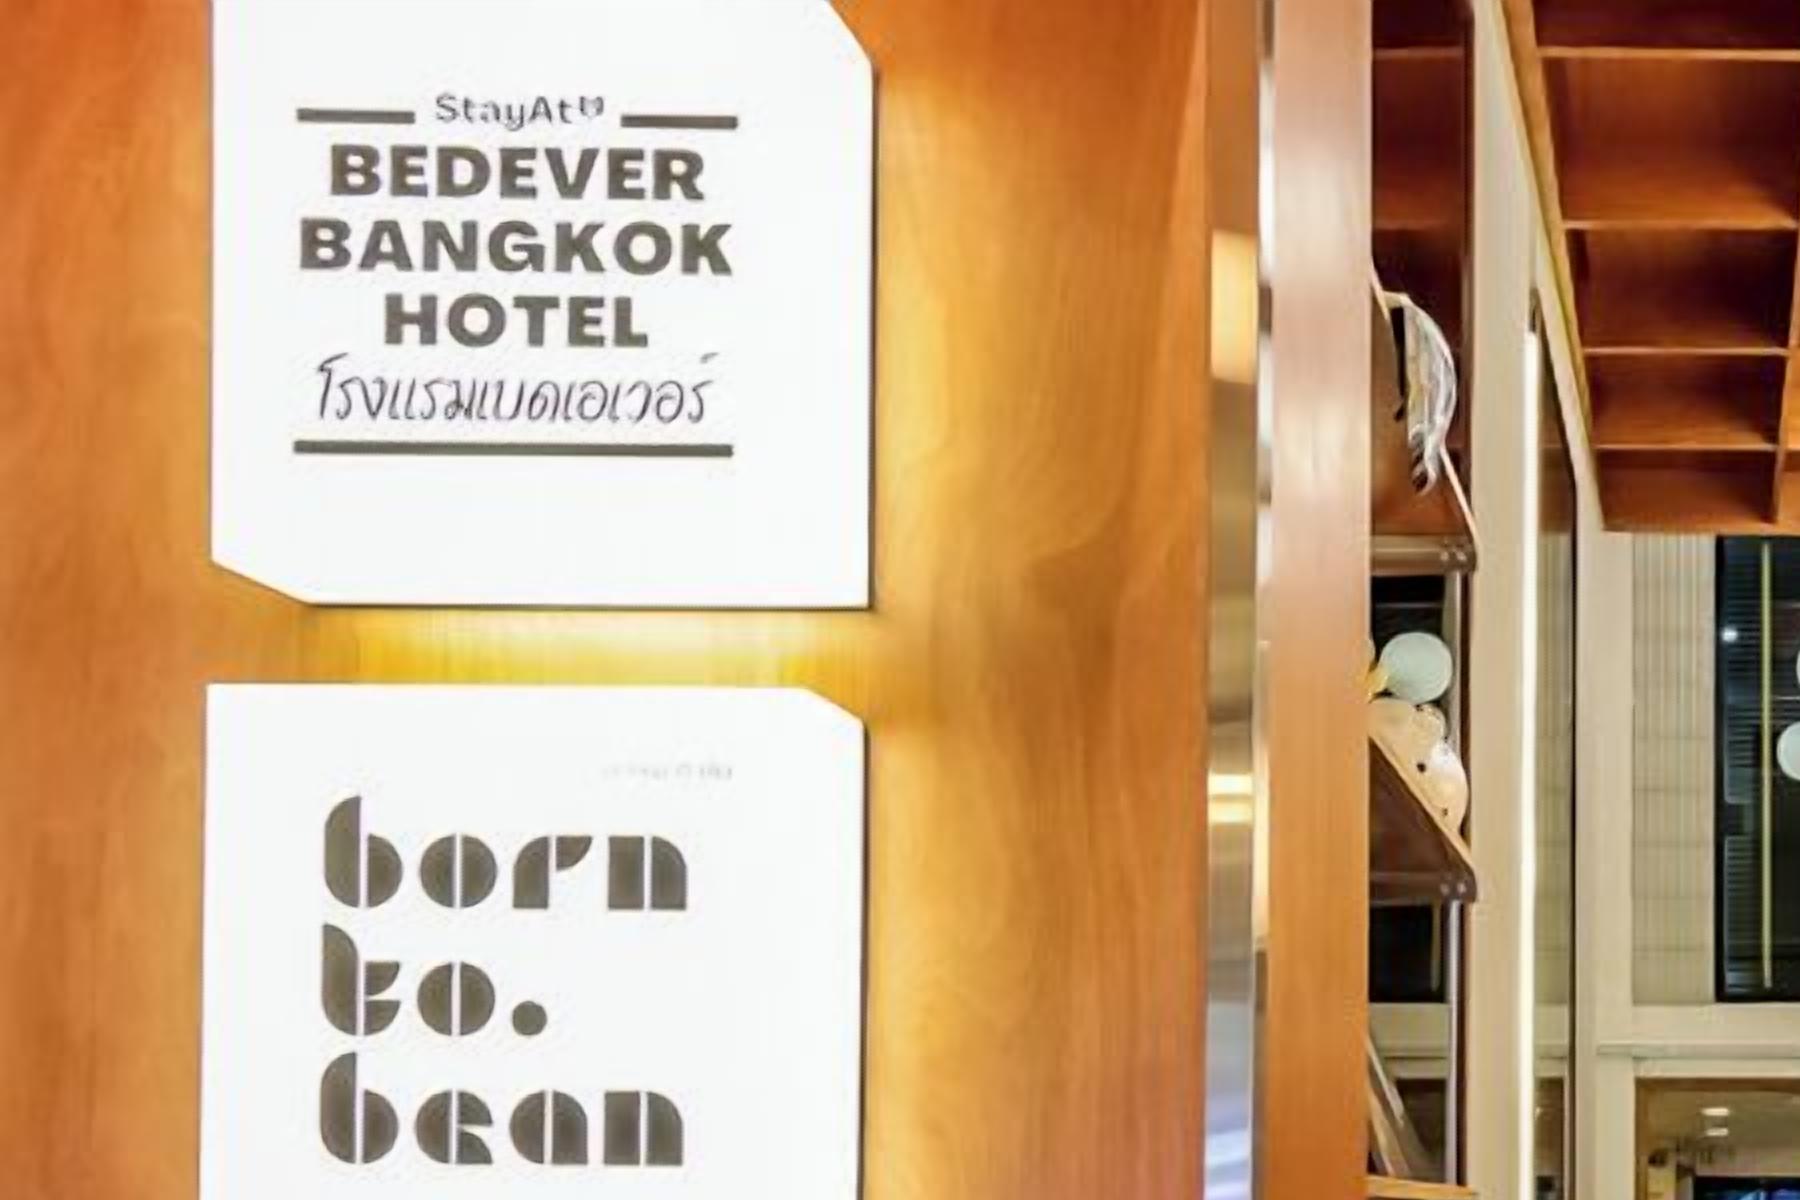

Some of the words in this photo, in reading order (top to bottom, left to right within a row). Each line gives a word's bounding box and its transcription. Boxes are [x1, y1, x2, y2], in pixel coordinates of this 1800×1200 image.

[330, 144, 705, 201] BEDEVER
[300, 218, 733, 276] BANGKOK
[384, 293, 649, 348] HOTEL
[323, 795, 688, 911] born
[319, 1051, 684, 1167] bean
